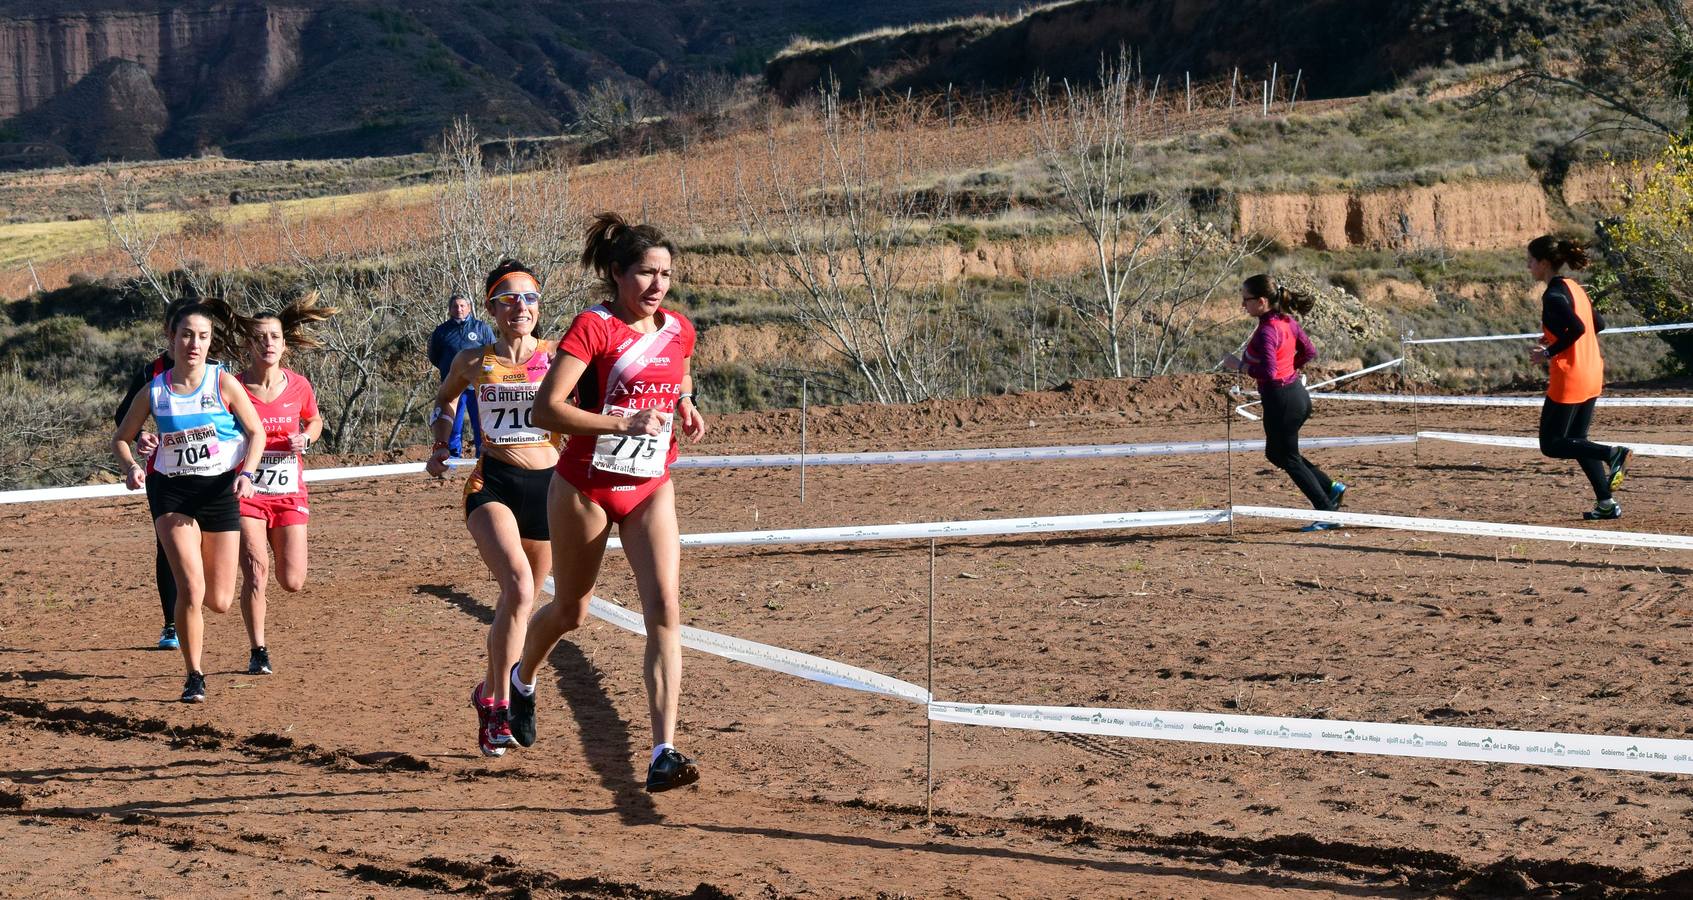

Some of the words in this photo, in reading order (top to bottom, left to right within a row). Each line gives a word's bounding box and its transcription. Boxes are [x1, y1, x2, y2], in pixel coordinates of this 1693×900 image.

[175, 430, 216, 444] ATLETISMO
[174, 444, 210, 466] 704
[611, 434, 658, 460] 775
[254, 469, 288, 486] 776
[1601, 748, 1624, 756] Gobierno
